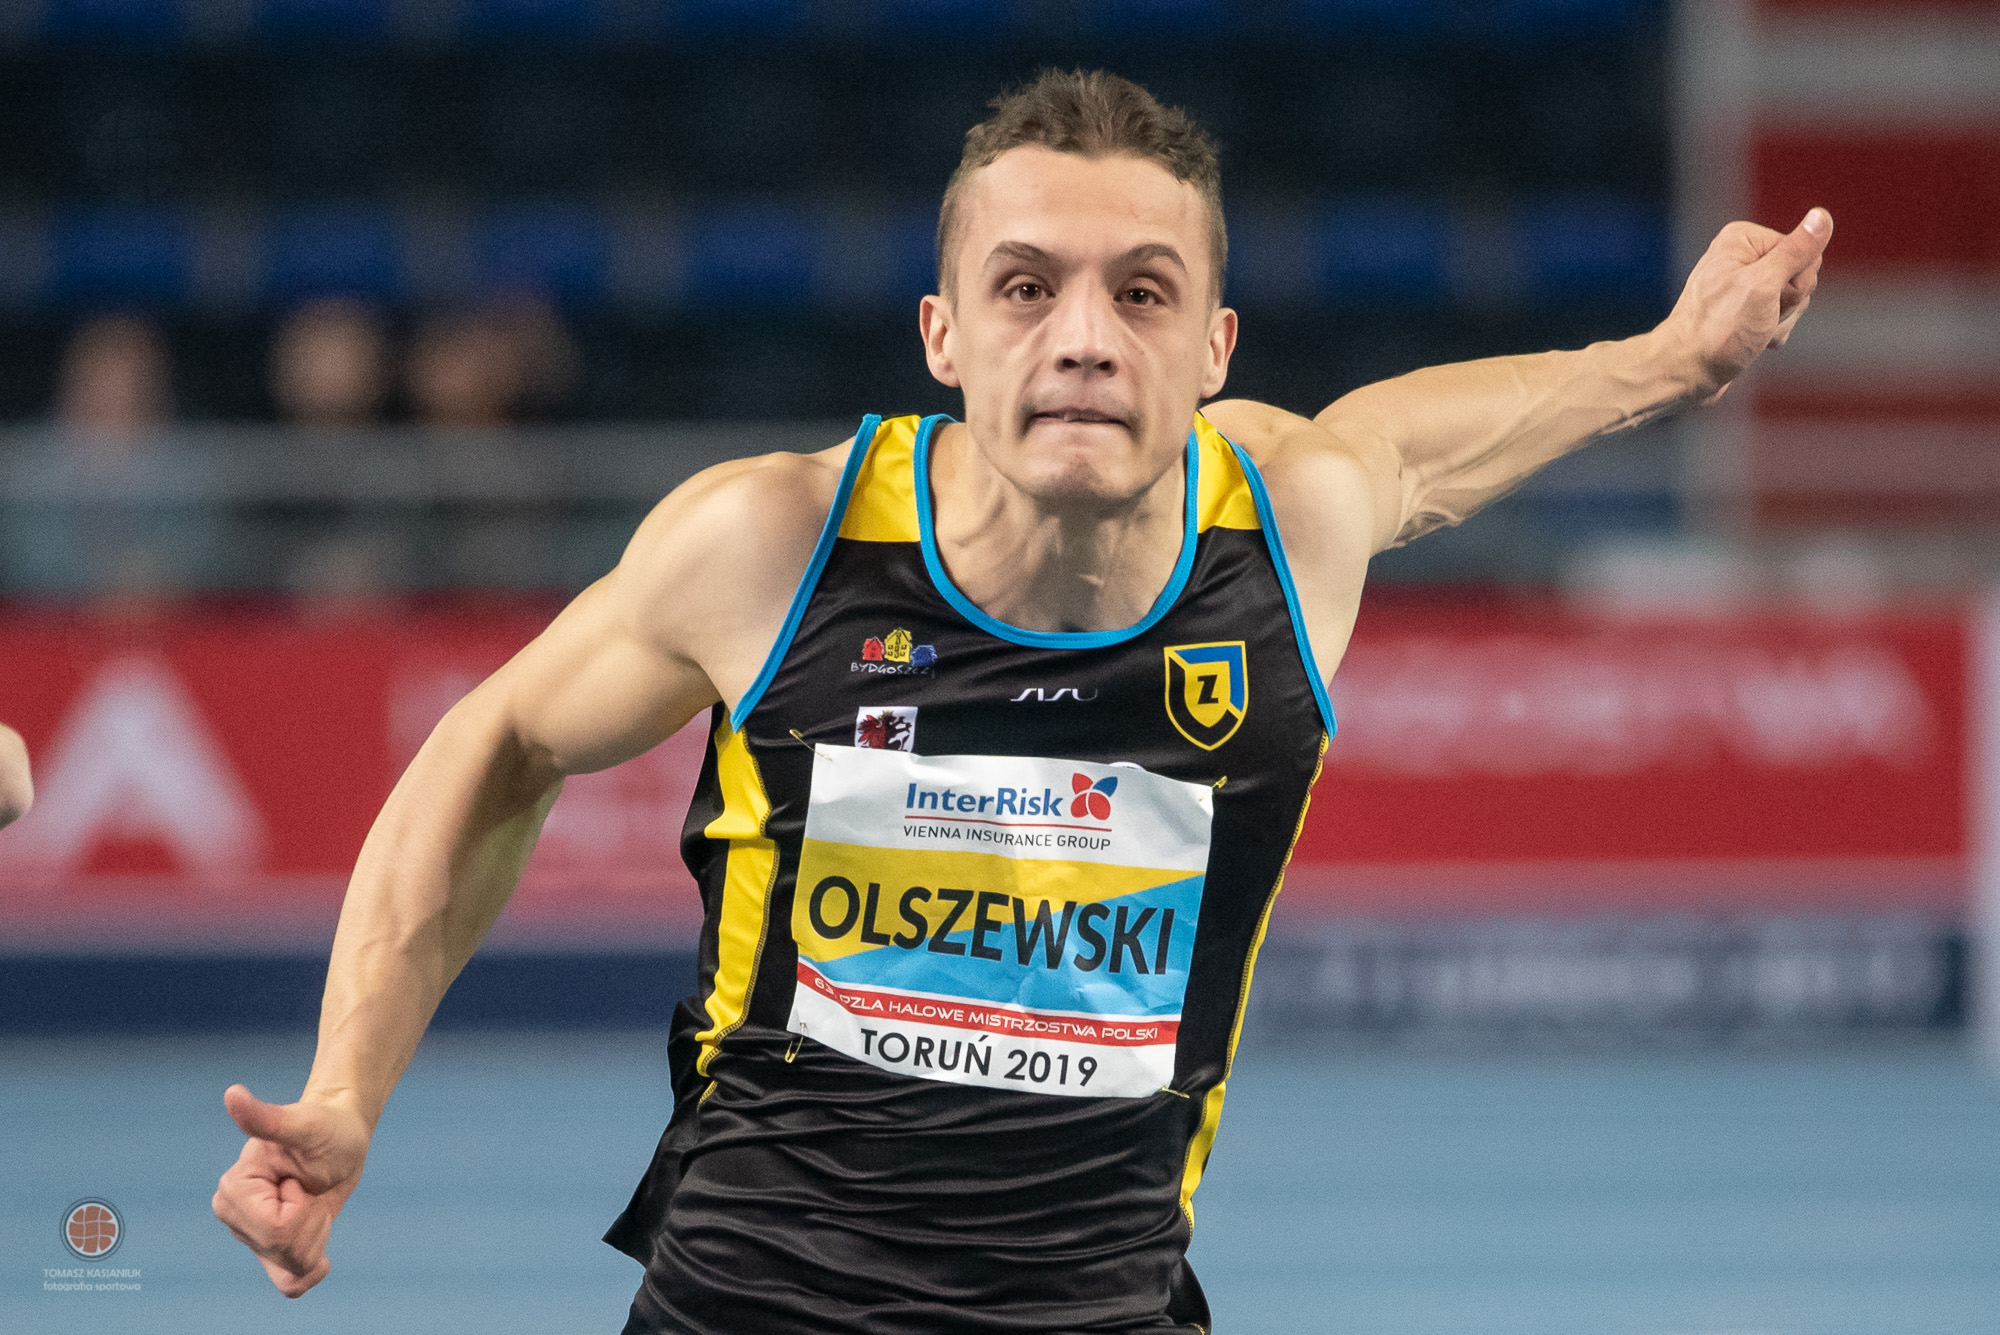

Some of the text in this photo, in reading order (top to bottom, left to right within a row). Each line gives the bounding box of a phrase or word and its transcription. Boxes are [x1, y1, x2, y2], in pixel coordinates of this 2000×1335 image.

[1197, 674, 1219, 705] Z
[905, 782, 1064, 817] InterRisk
[903, 825, 1111, 851] VIENNA INSURANCE GROUP
[808, 874, 1175, 976] OLSZEWSKI
[889, 1001, 964, 1022] HALOWE
[968, 1012, 1097, 1038] MISTRZOSTWA
[1101, 1027, 1158, 1041] POLSKI
[860, 1028, 1098, 1087] TORUŃ 2019
